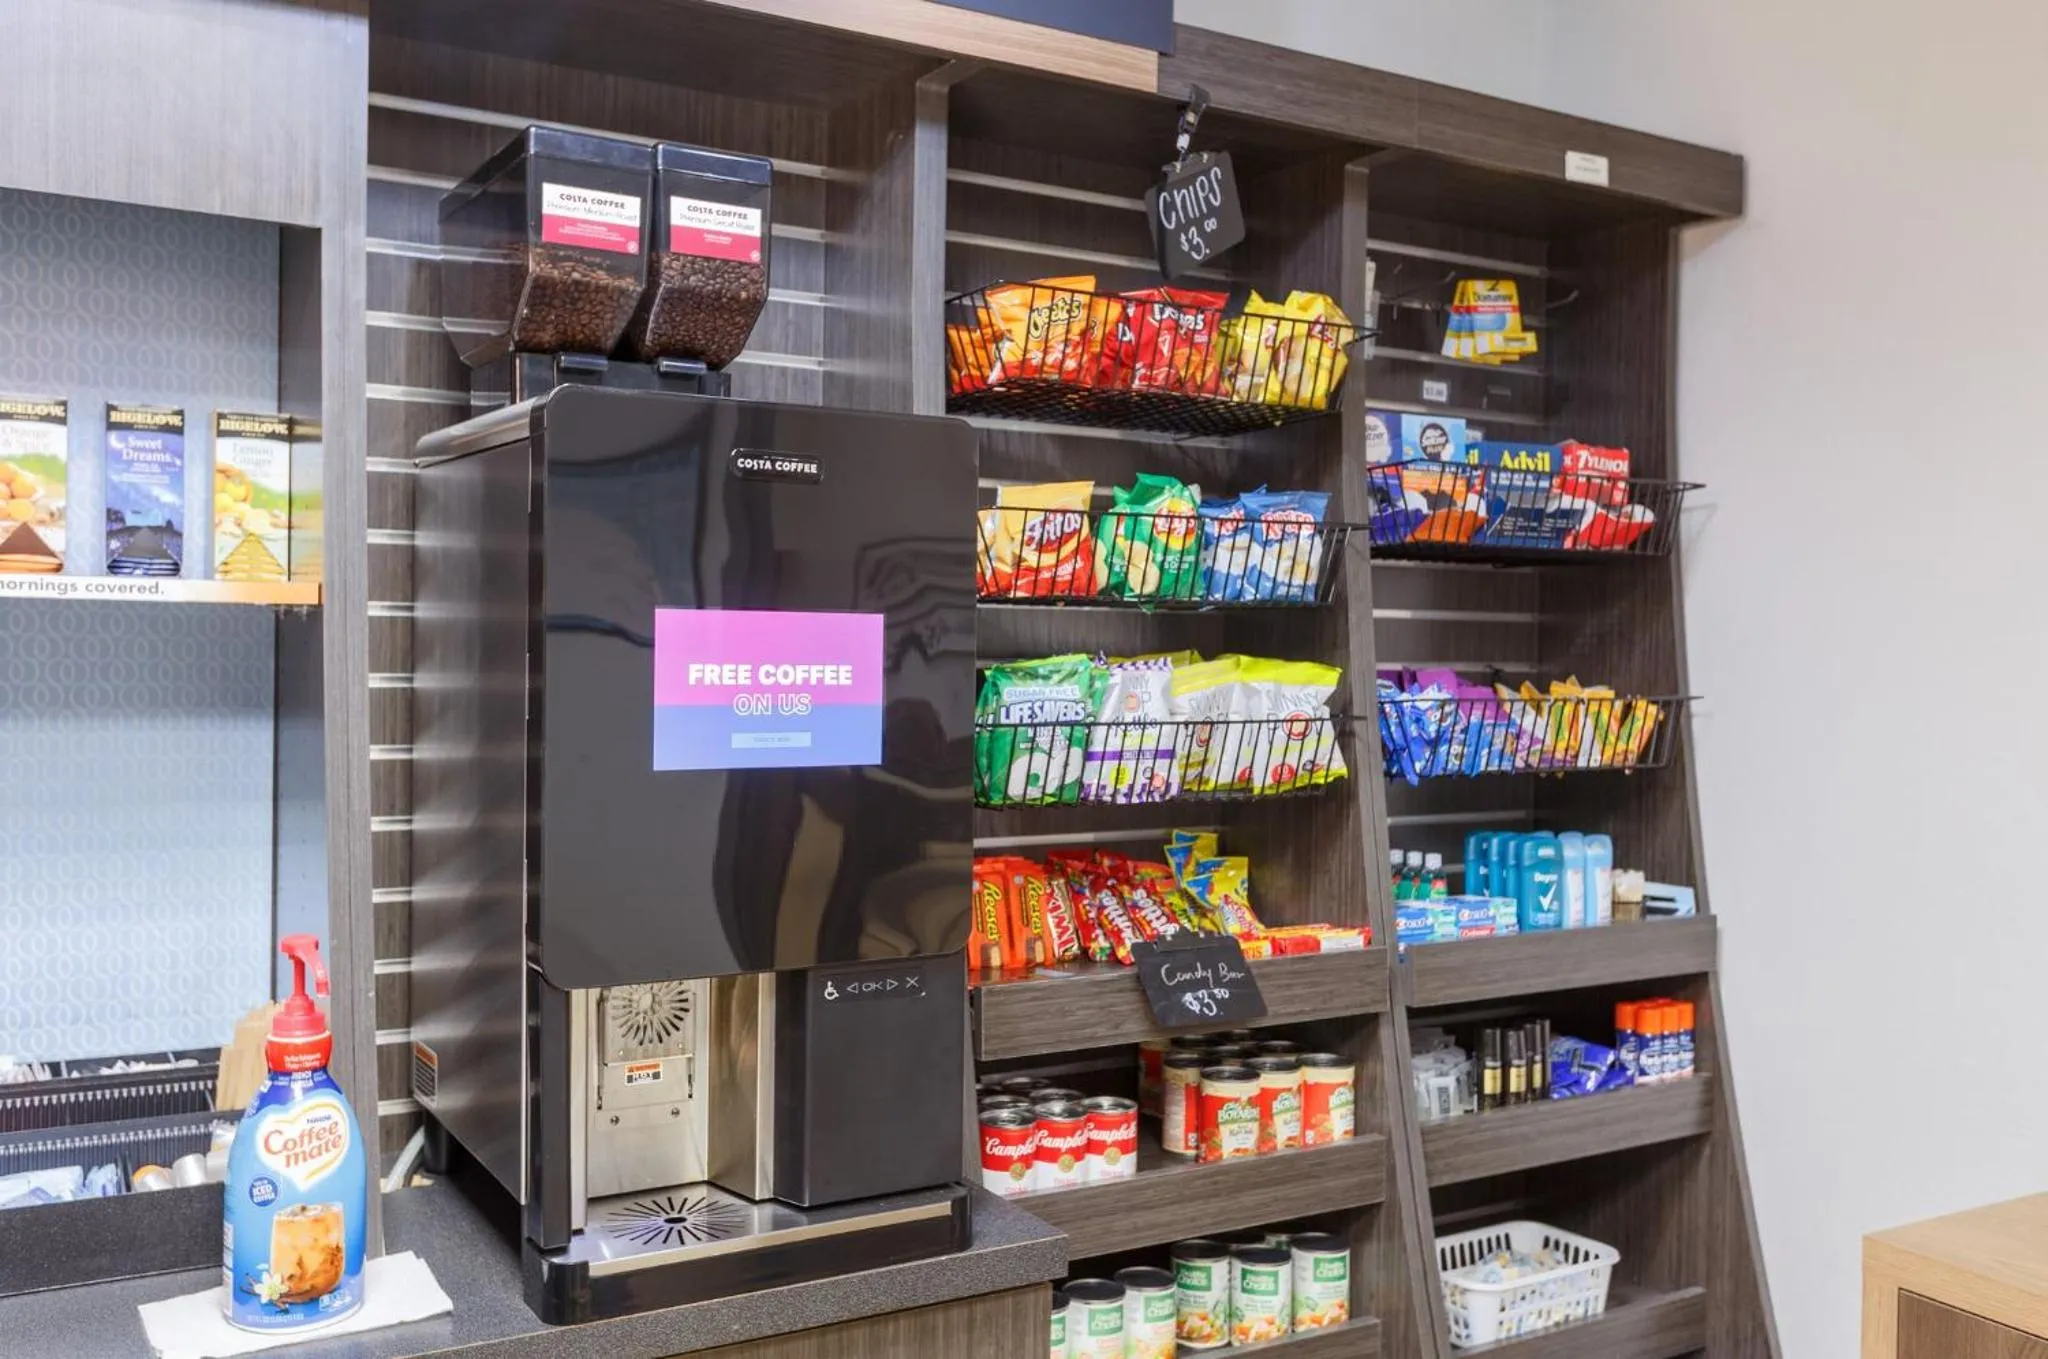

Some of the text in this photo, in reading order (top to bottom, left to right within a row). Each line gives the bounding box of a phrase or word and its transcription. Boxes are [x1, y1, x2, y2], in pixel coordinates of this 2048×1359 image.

[559, 192, 626, 210] COSTA COFFEE
[687, 204, 749, 221] COSTA COFFEE
[127, 435, 163, 450] Sweet
[122, 447, 173, 463] Dreams
[1500, 449, 1551, 473] Advil
[737, 458, 818, 474] COSTA COFFEE
[85, 581, 165, 595] covered.
[688, 664, 853, 686] FREE COFFEE
[1007, 685, 1079, 699] SUGAR FREE
[733, 693, 813, 716] ON US
[1160, 961, 1215, 988] Candy
[861, 982, 884, 993] OK
[263, 1120, 339, 1156] Coffee
[284, 1134, 343, 1169] mate
